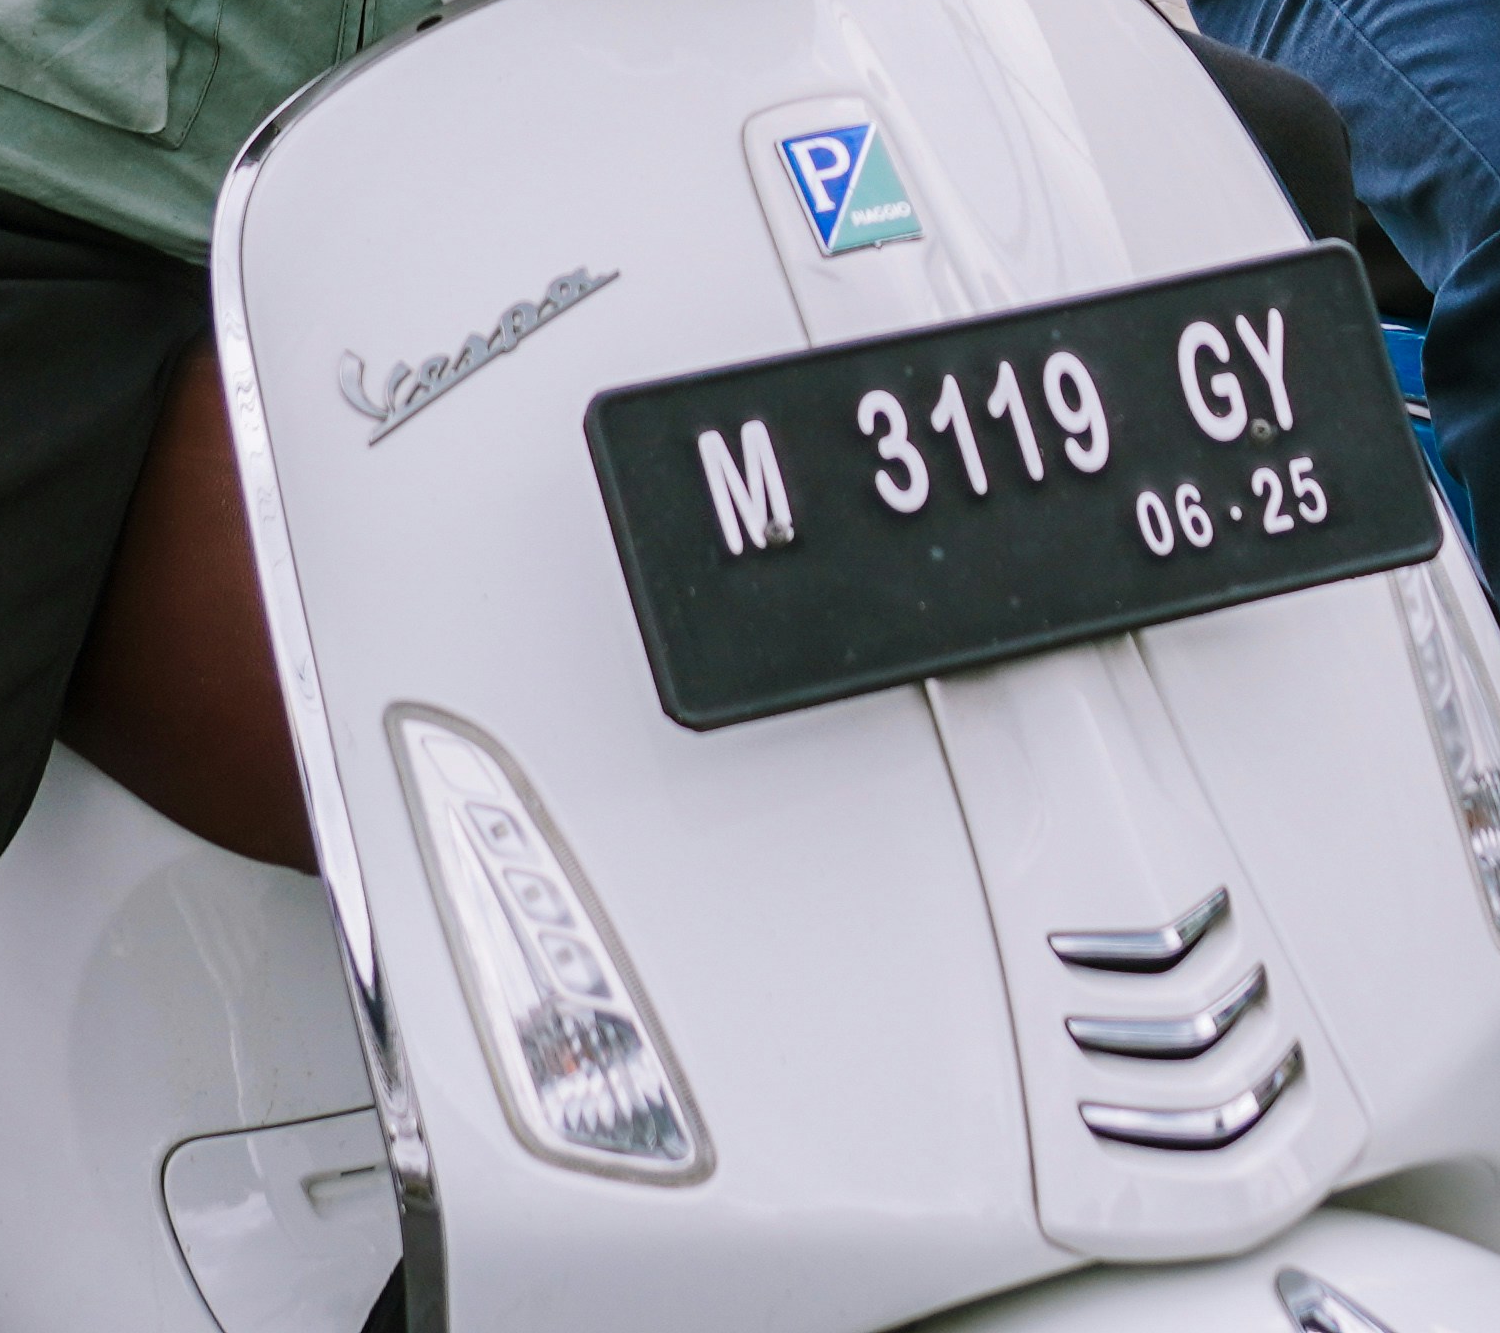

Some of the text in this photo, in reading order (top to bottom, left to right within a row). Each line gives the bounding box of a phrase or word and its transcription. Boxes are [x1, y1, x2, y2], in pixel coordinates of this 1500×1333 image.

[789, 135, 851, 214] P
[850, 200, 912, 227] PIAGGIO
[339, 266, 621, 446] Vespa
[698, 306, 1295, 558] M 3119 GY
